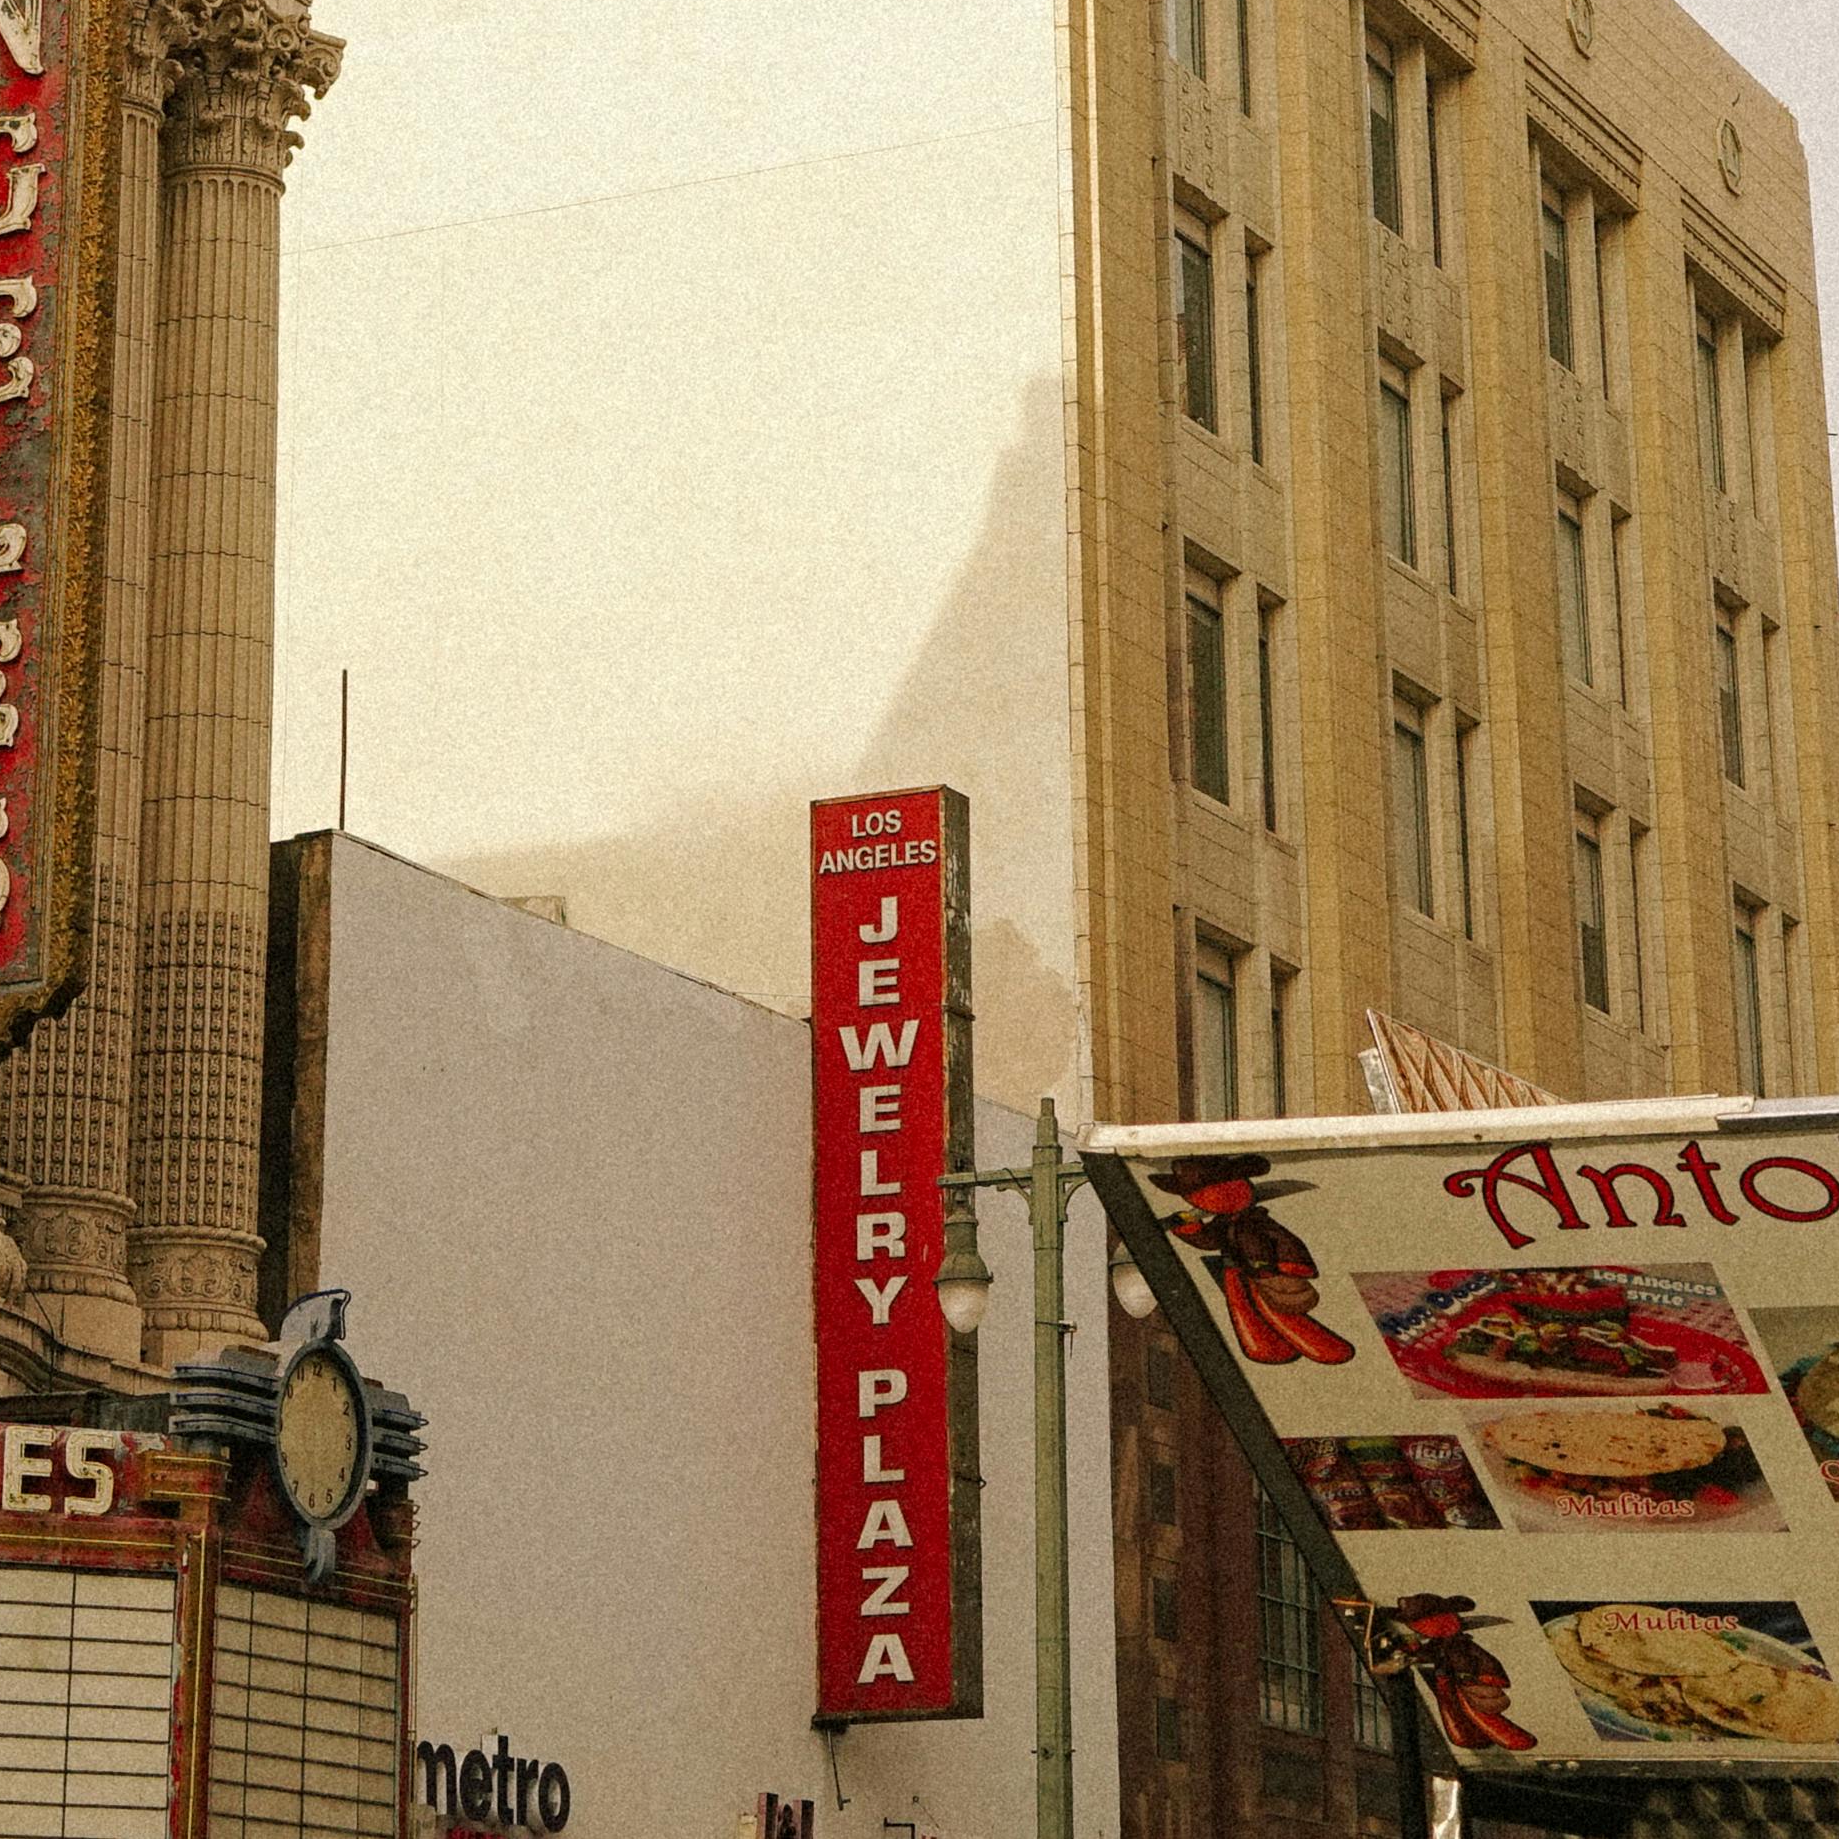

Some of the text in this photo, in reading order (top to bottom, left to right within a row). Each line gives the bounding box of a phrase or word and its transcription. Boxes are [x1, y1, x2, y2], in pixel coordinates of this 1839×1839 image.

[851, 809, 902, 838] LOS
[818, 839, 937, 875] ANGELES
[838, 895, 921, 1686] JEWELRY PLAZA
[1556, 1492, 1695, 1518] Mulitas
[1604, 1608, 1741, 1631] Mulitas
[417, 1735, 571, 1833] metro
